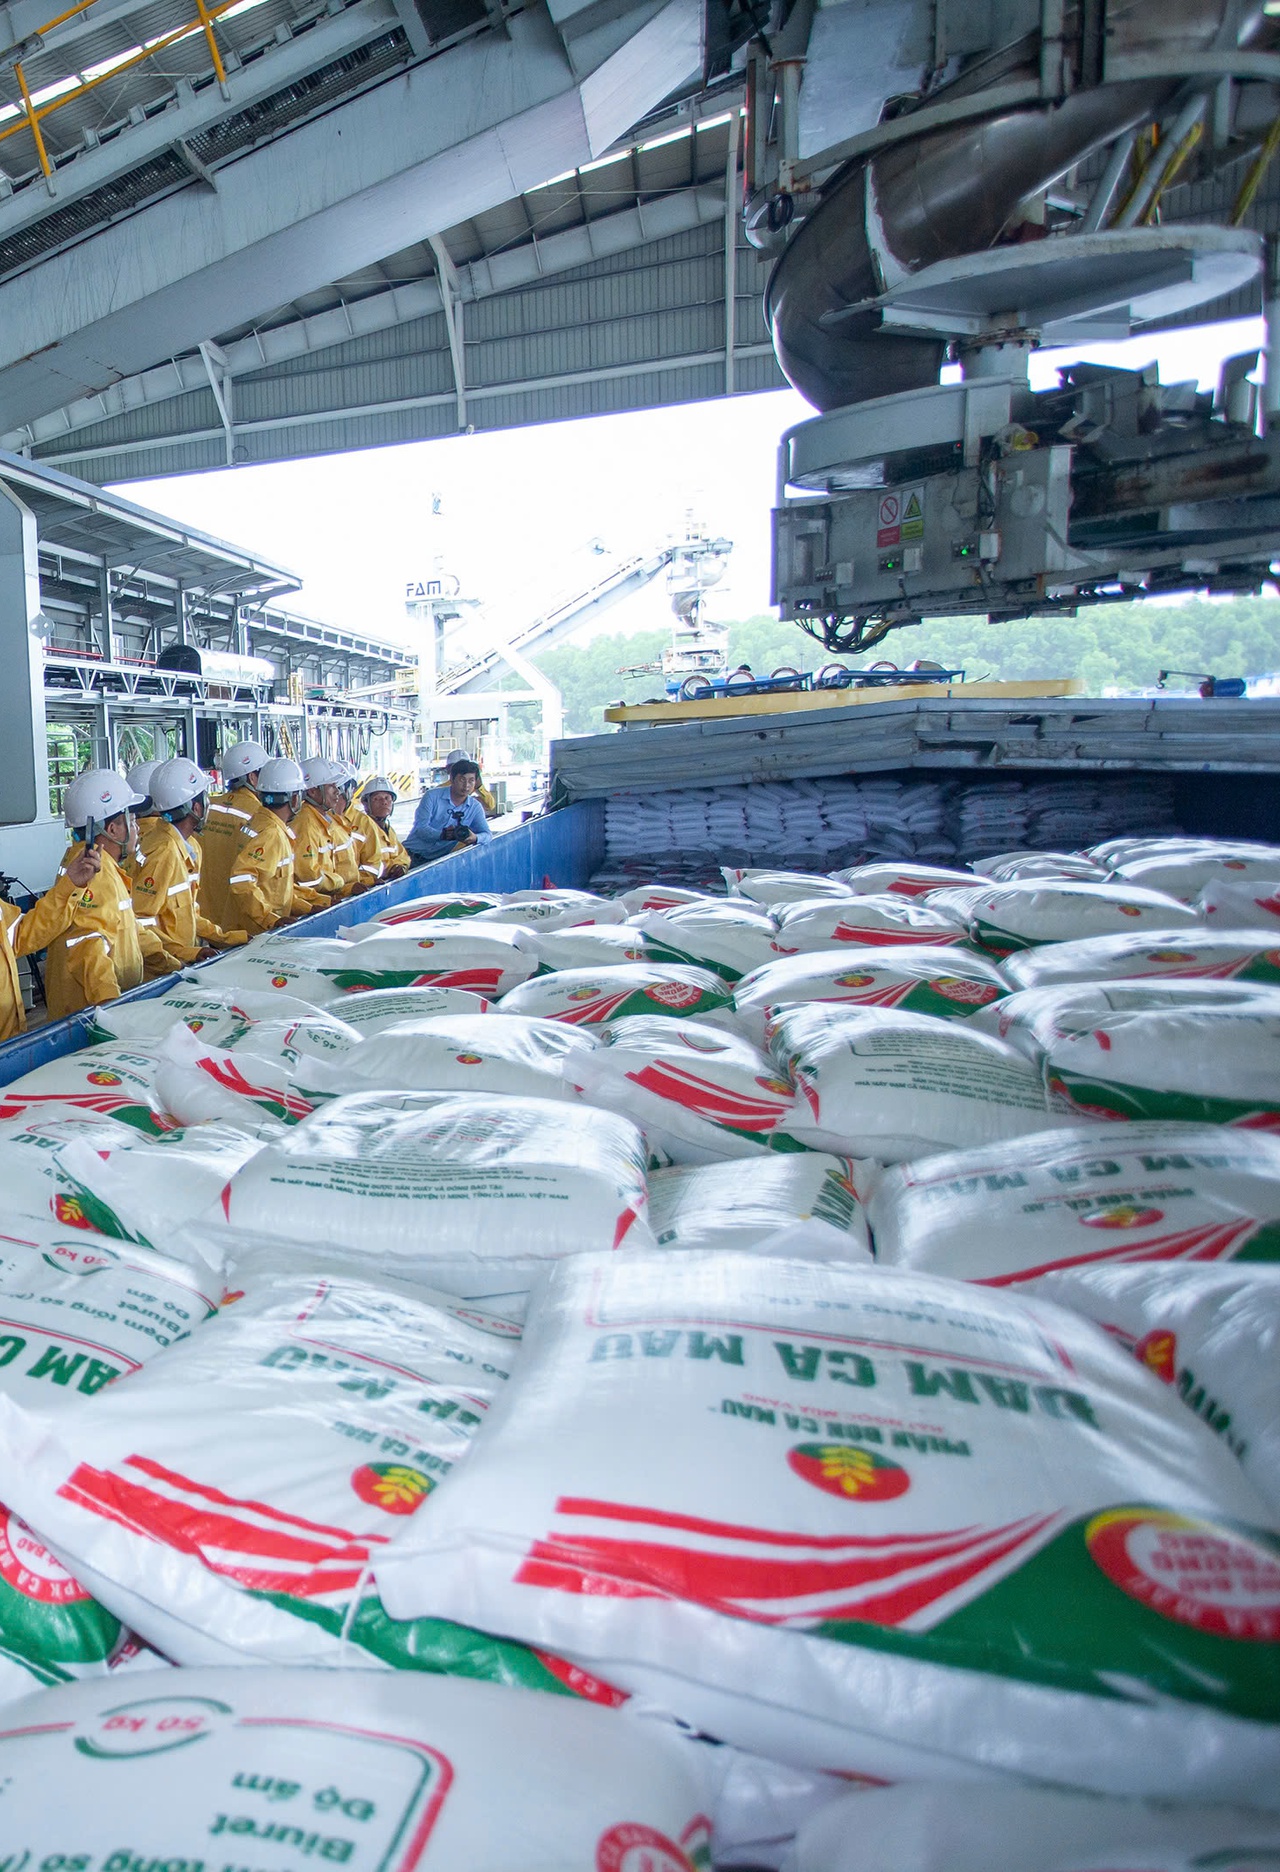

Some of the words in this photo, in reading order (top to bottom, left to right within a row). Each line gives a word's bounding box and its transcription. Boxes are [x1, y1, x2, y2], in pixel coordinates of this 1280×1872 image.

[406, 580, 441, 597] FAM
[55, 1246, 78, 1262] kg
[70, 1299, 117, 1324] tổng
[116, 1300, 181, 1334] Biuret
[124, 1318, 171, 1349] Đạm
[586, 1329, 747, 1367] MAU
[719, 1398, 777, 1429] MAU
[380, 1436, 410, 1457] CÀ
[826, 1422, 884, 1444] BÓN
[890, 1428, 972, 1458] PHÂN
[16, 1536, 47, 1559] BAO
[102, 1713, 149, 1735] kg
[156, 1715, 207, 1733] 50
[231, 1772, 302, 1803] ẩm
[313, 1786, 377, 1825] Độ
[207, 1814, 357, 1865] Biuret
